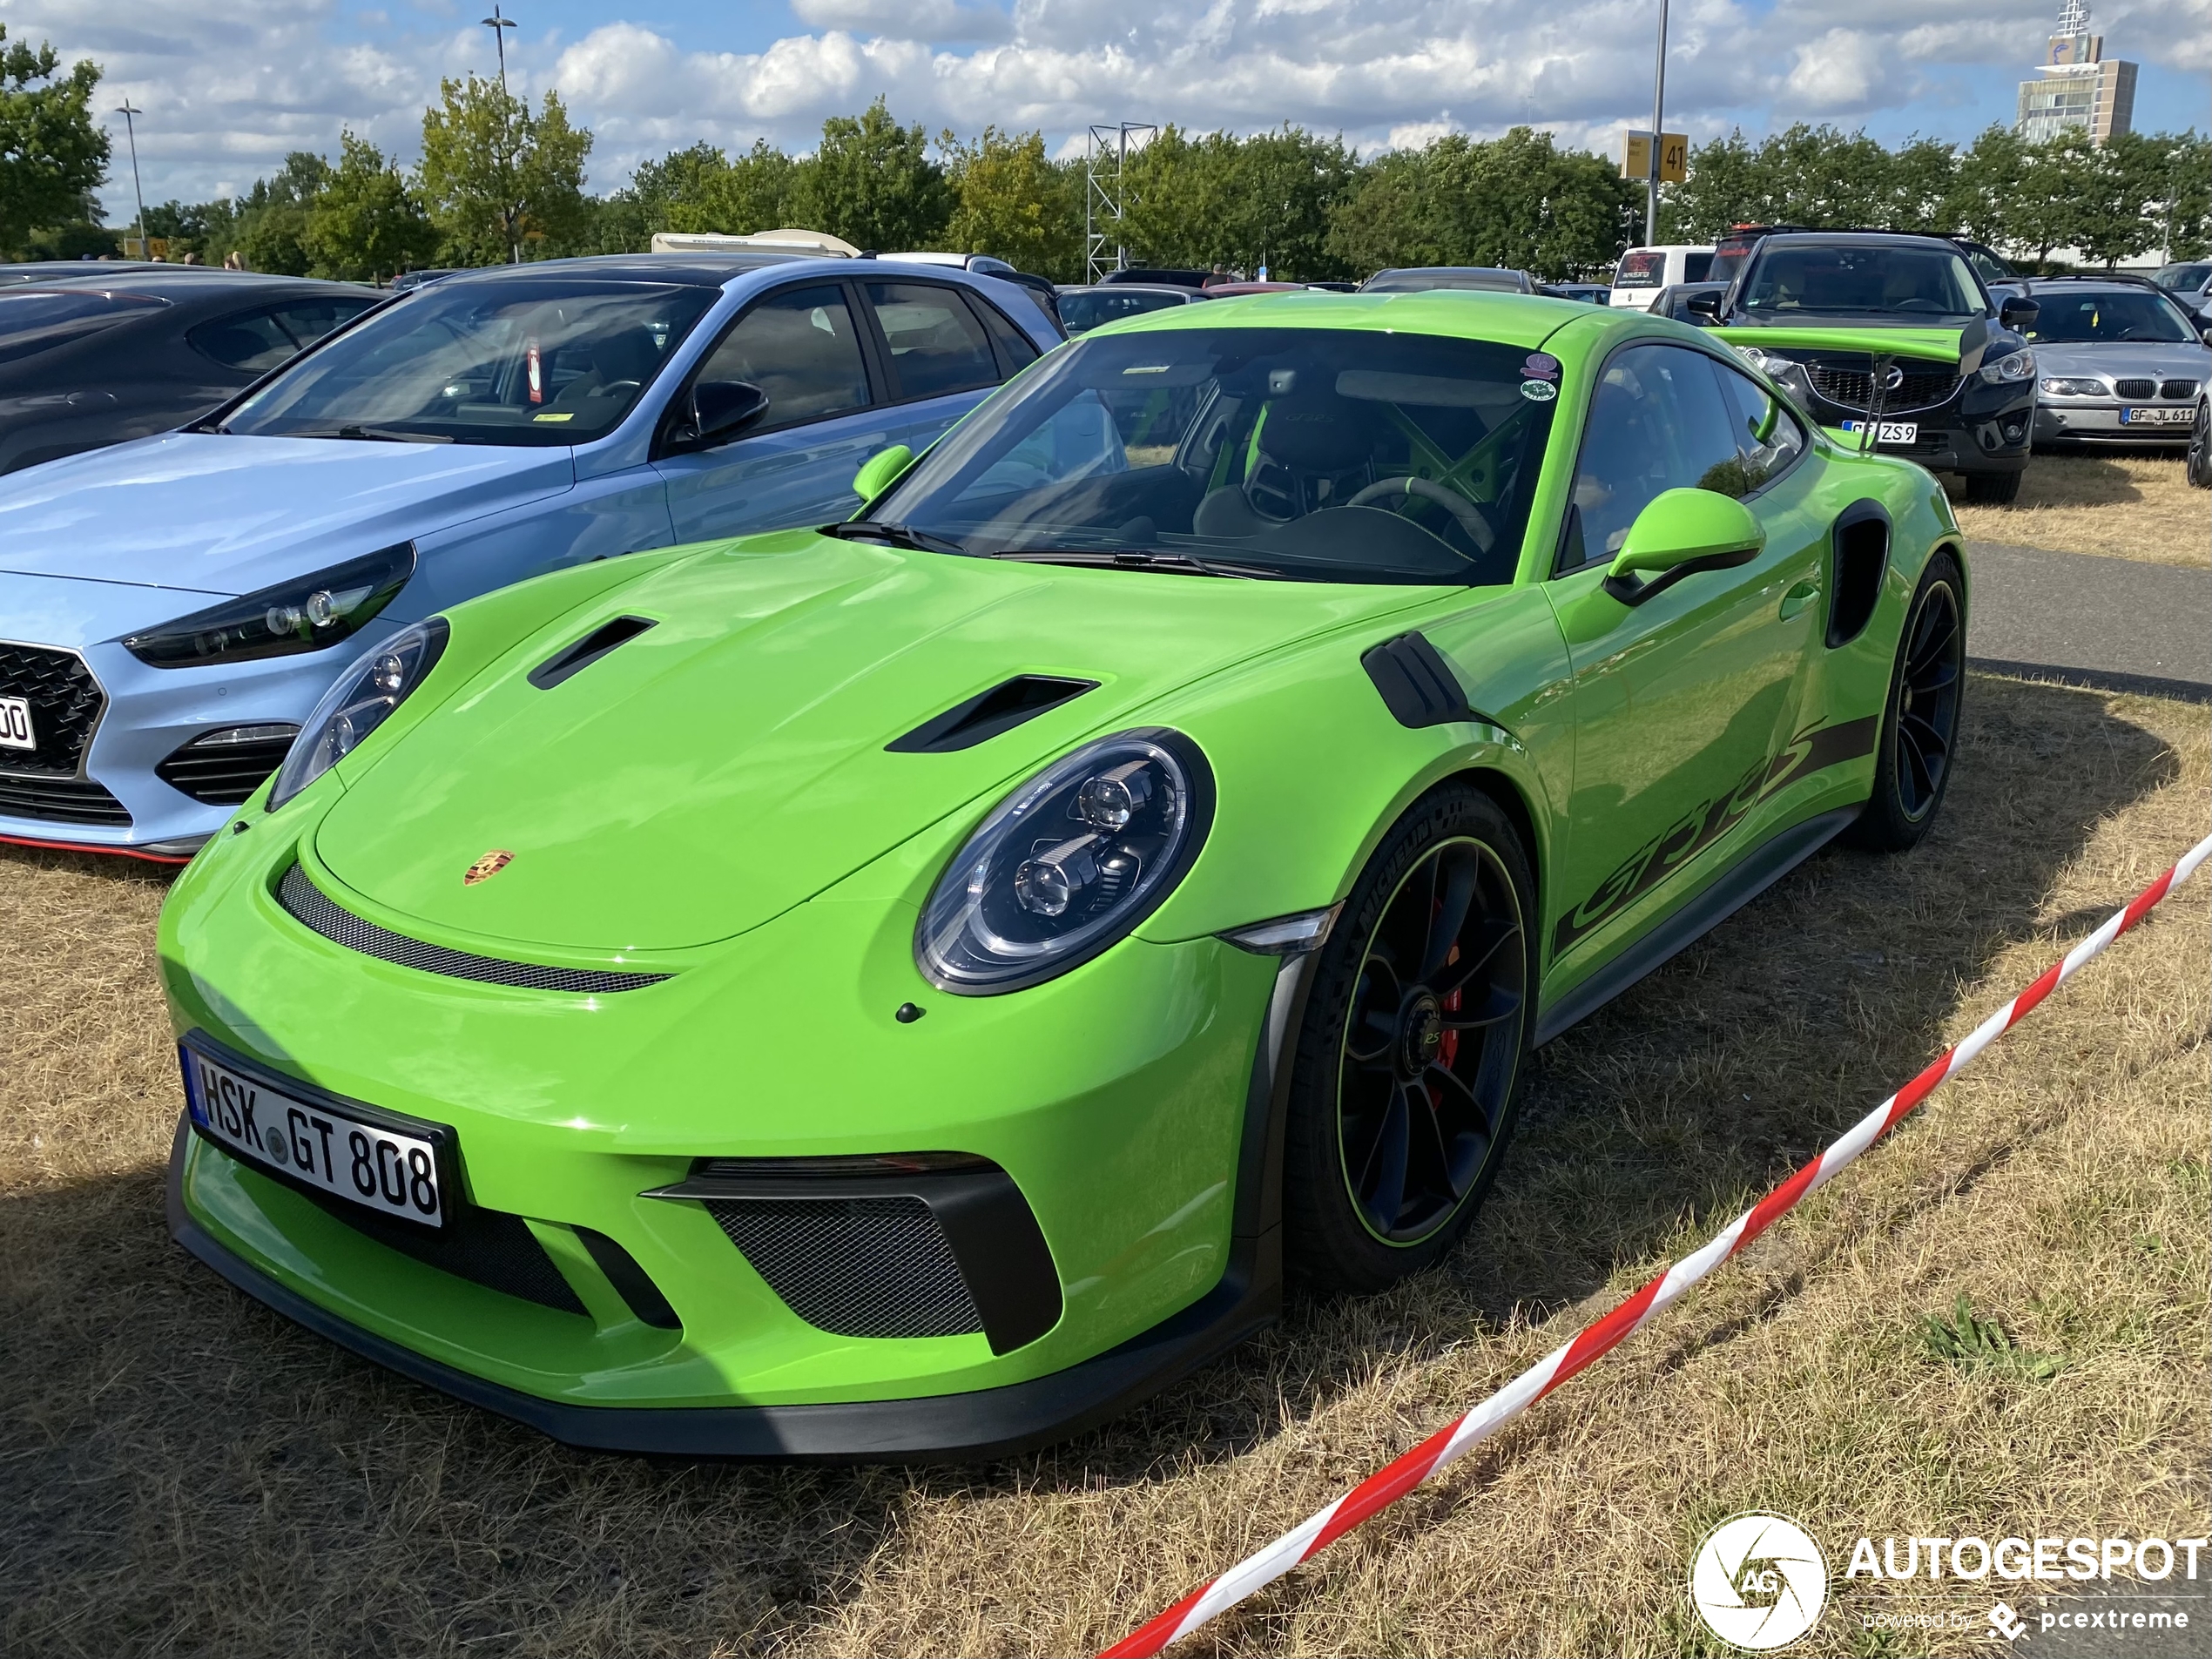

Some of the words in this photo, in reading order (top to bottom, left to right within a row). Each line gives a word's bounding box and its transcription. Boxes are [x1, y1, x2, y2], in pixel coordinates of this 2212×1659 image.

[1666, 145, 1683, 170] 41
[2130, 409, 2148, 421] GF
[2154, 409, 2170, 421] JL
[2172, 409, 2194, 421] 611
[1881, 425, 1903, 440] ZS
[1905, 426, 1915, 441] 9
[200, 1063, 265, 1152] HSK
[287, 1107, 334, 1184] GT
[348, 1130, 438, 1216] 808
